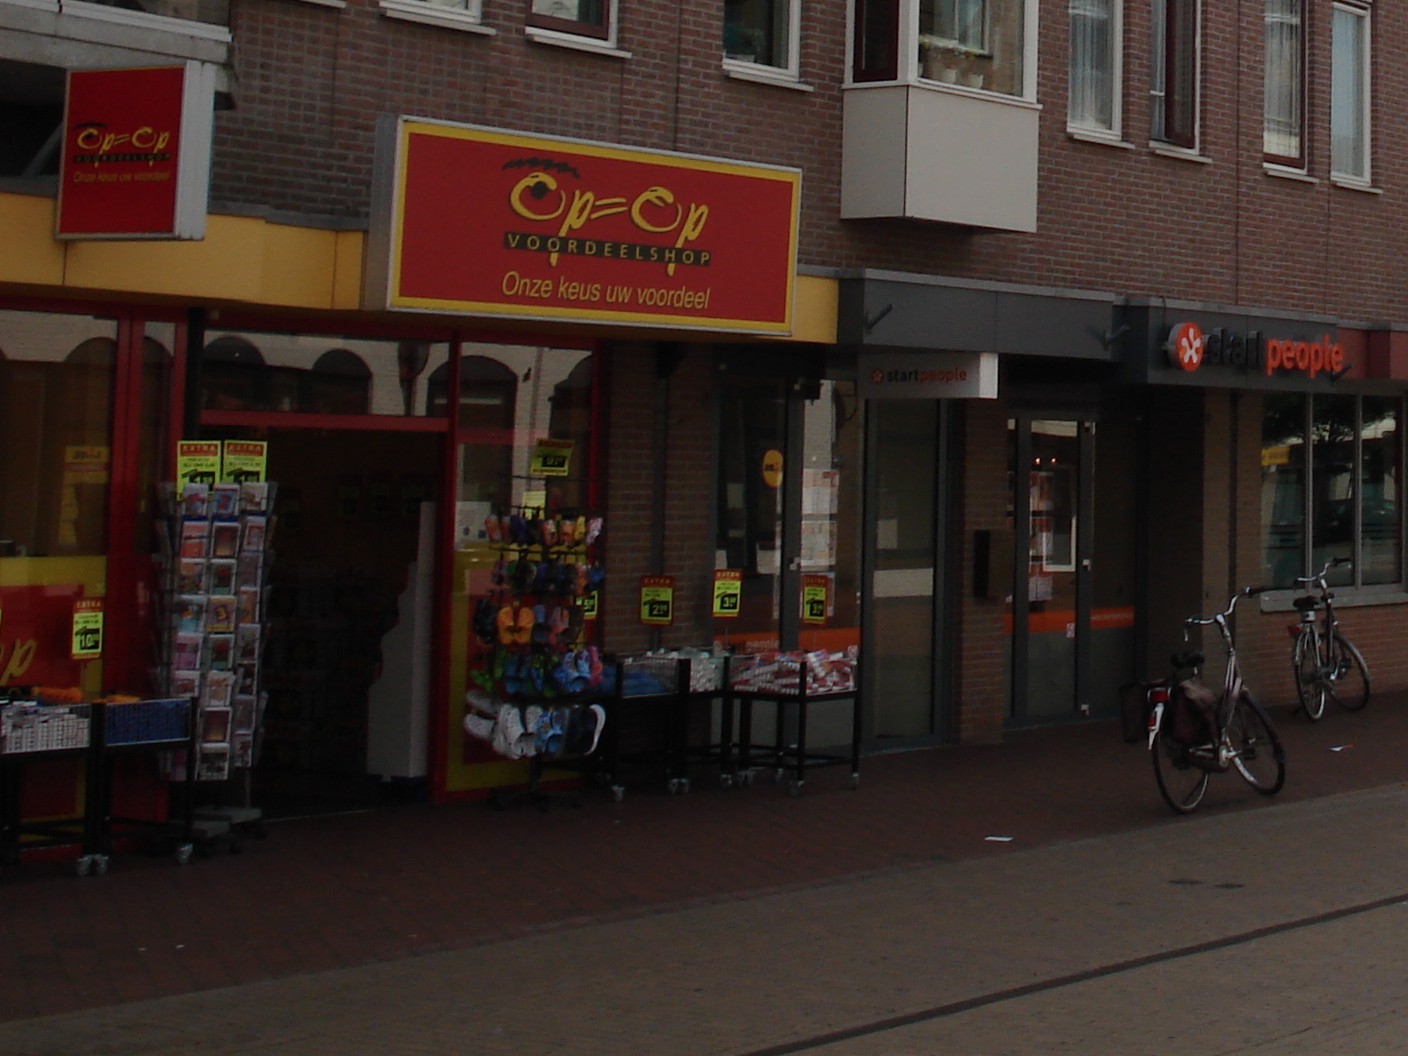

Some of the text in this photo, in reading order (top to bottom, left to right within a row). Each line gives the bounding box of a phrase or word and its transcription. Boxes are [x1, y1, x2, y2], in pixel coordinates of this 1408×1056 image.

[506, 234, 711, 265] VOORDEELSHOP
[501, 270, 711, 310] Onze keus uw voordeel
[181, 444, 217, 452] EXTRA
[228, 443, 263, 452] EXTRA
[0, 637, 38, 687] p
